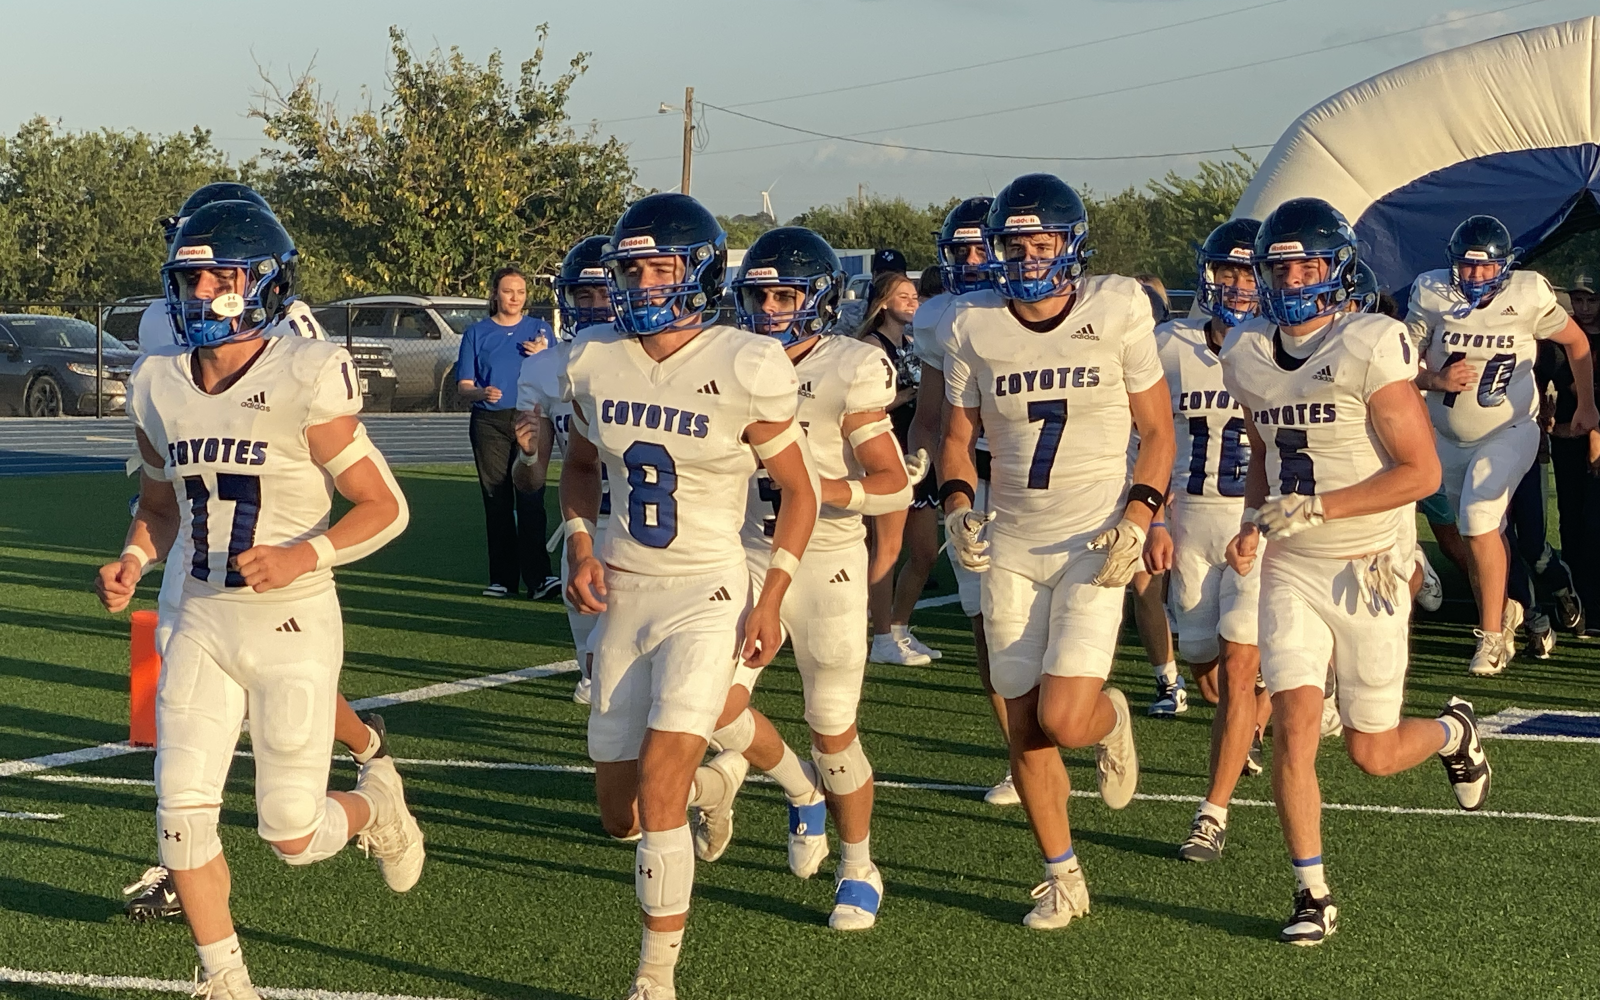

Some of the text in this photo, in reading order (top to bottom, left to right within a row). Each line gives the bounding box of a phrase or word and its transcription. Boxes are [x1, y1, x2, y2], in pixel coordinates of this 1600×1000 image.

[620, 238, 649, 247] Riddell
[1070, 333, 1100, 341] adidas
[1441, 331, 1515, 349] COYOTES
[995, 366, 1100, 397] COYOTES
[240, 400, 271, 412] adidas
[1179, 390, 1241, 411] COYO
[601, 399, 710, 439] COYOTES
[168, 437, 269, 468] COYOTES
[1027, 398, 1068, 490] 7
[623, 440, 678, 549] 8
[182, 472, 262, 588] 17
